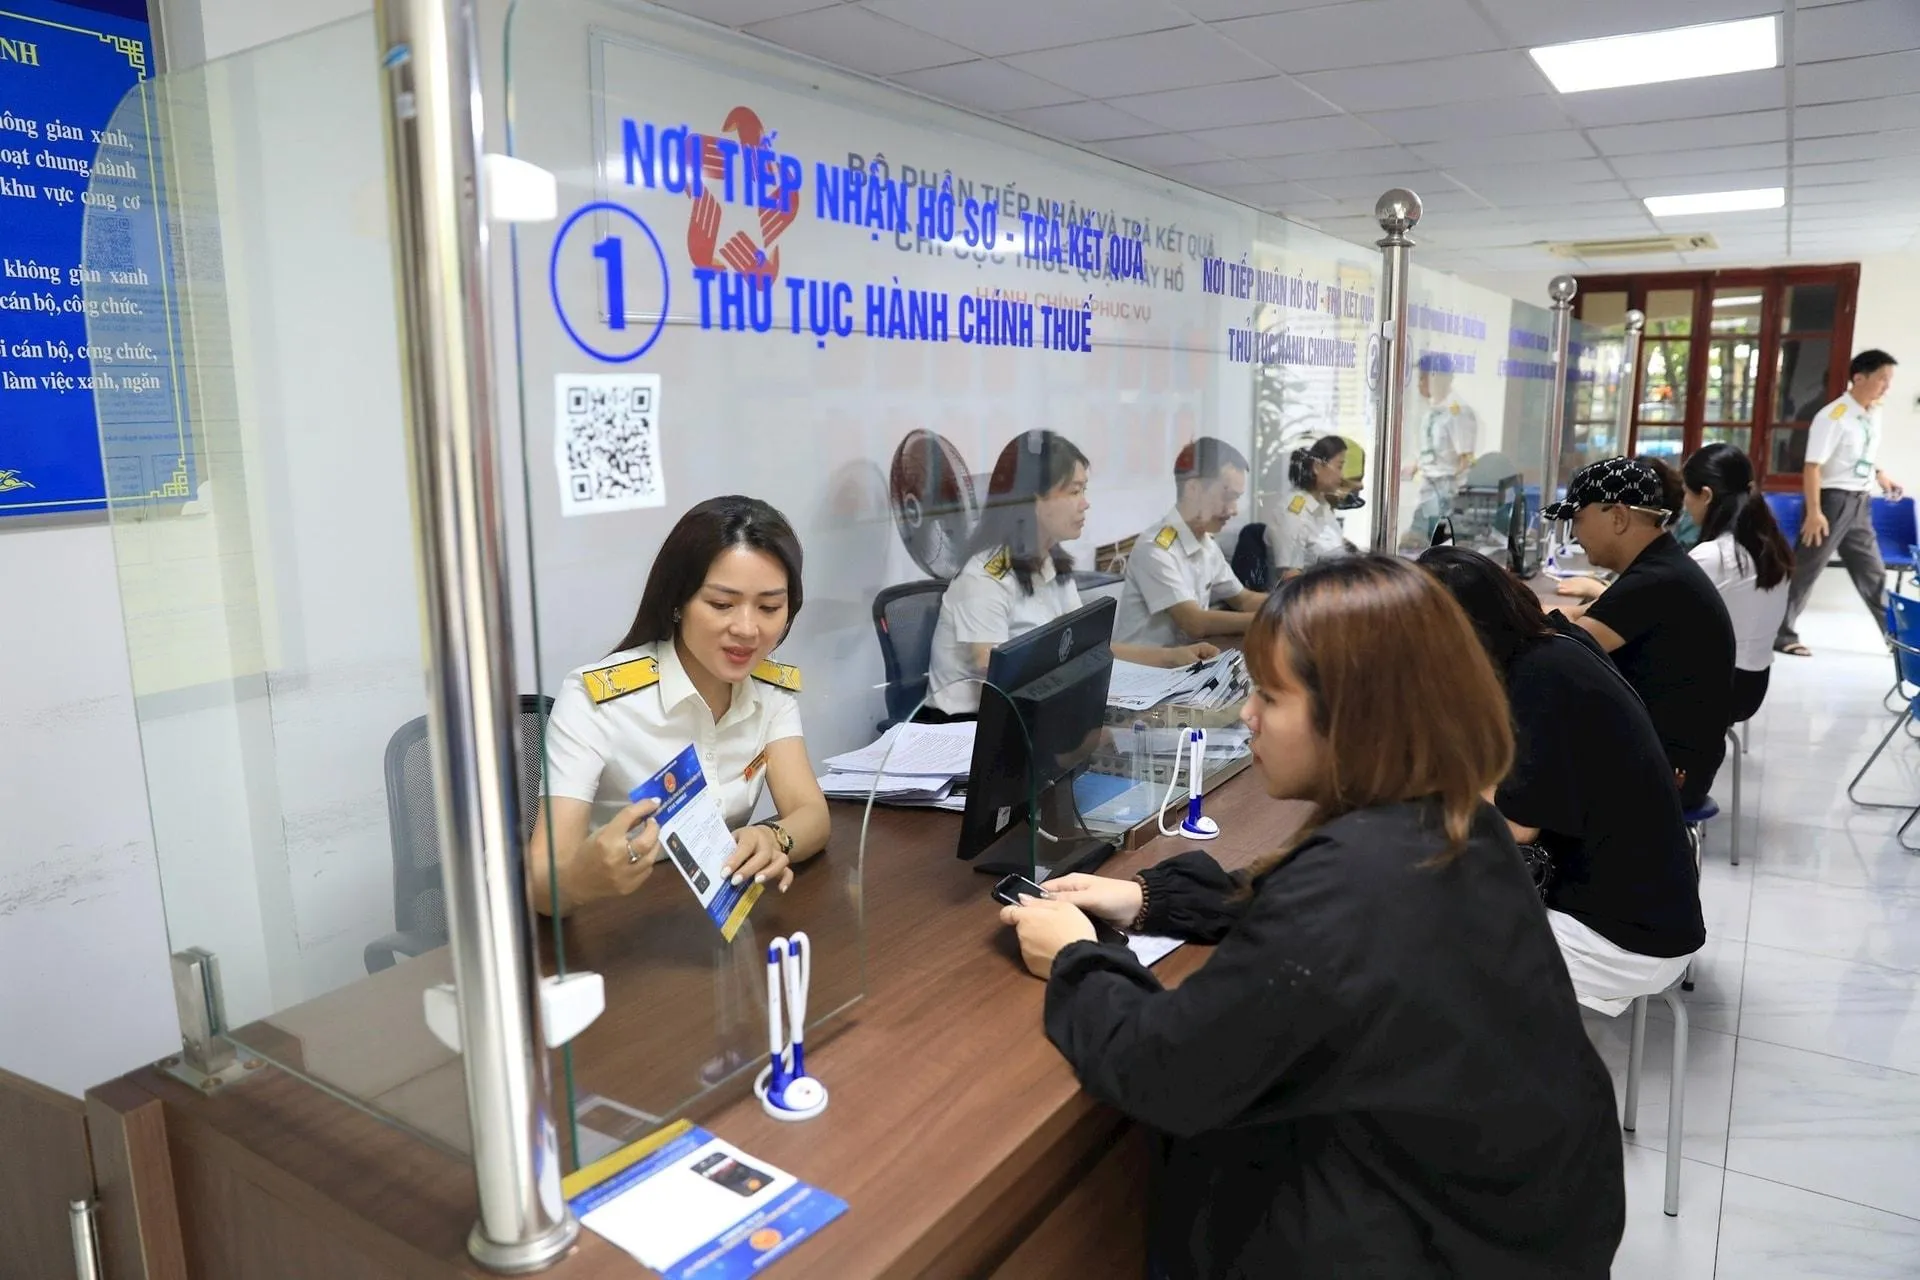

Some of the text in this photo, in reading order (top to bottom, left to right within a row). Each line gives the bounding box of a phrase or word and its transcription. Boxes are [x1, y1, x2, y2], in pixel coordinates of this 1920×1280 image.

[46, 119, 84, 141] gian
[0, 148, 30, 170] oạt
[0, 176, 37, 199] khu
[43, 185, 74, 207] vực
[123, 194, 140, 210] cơ
[621, 117, 703, 199] NƠI
[716, 130, 802, 213] TIẾP
[816, 161, 907, 241] NHẬN
[918, 173, 955, 242] HỒ
[964, 197, 998, 250] SƠ
[1021, 201, 1062, 265] TRẢ
[1068, 210, 1104, 271] KẾT
[1109, 223, 1144, 281] QUẢ
[4, 258, 61, 285] không
[109, 268, 149, 285] xanh
[592, 237, 626, 330] 1
[1203, 257, 1225, 295] NƠI
[1229, 252, 1254, 300] TIẾP
[0, 290, 32, 311] cán
[32, 292, 61, 316] bộ,
[101, 296, 143, 315] chức.
[693, 250, 1092, 352] THỦ TỤC HÀNH CHÍNH THUẾ
[11, 339, 43, 358] cán
[46, 340, 74, 363] bộ,
[116, 342, 157, 362] chức,
[1228, 317, 1252, 363] THỦ
[2, 371, 160, 394] làm việc xanh, ngăn
